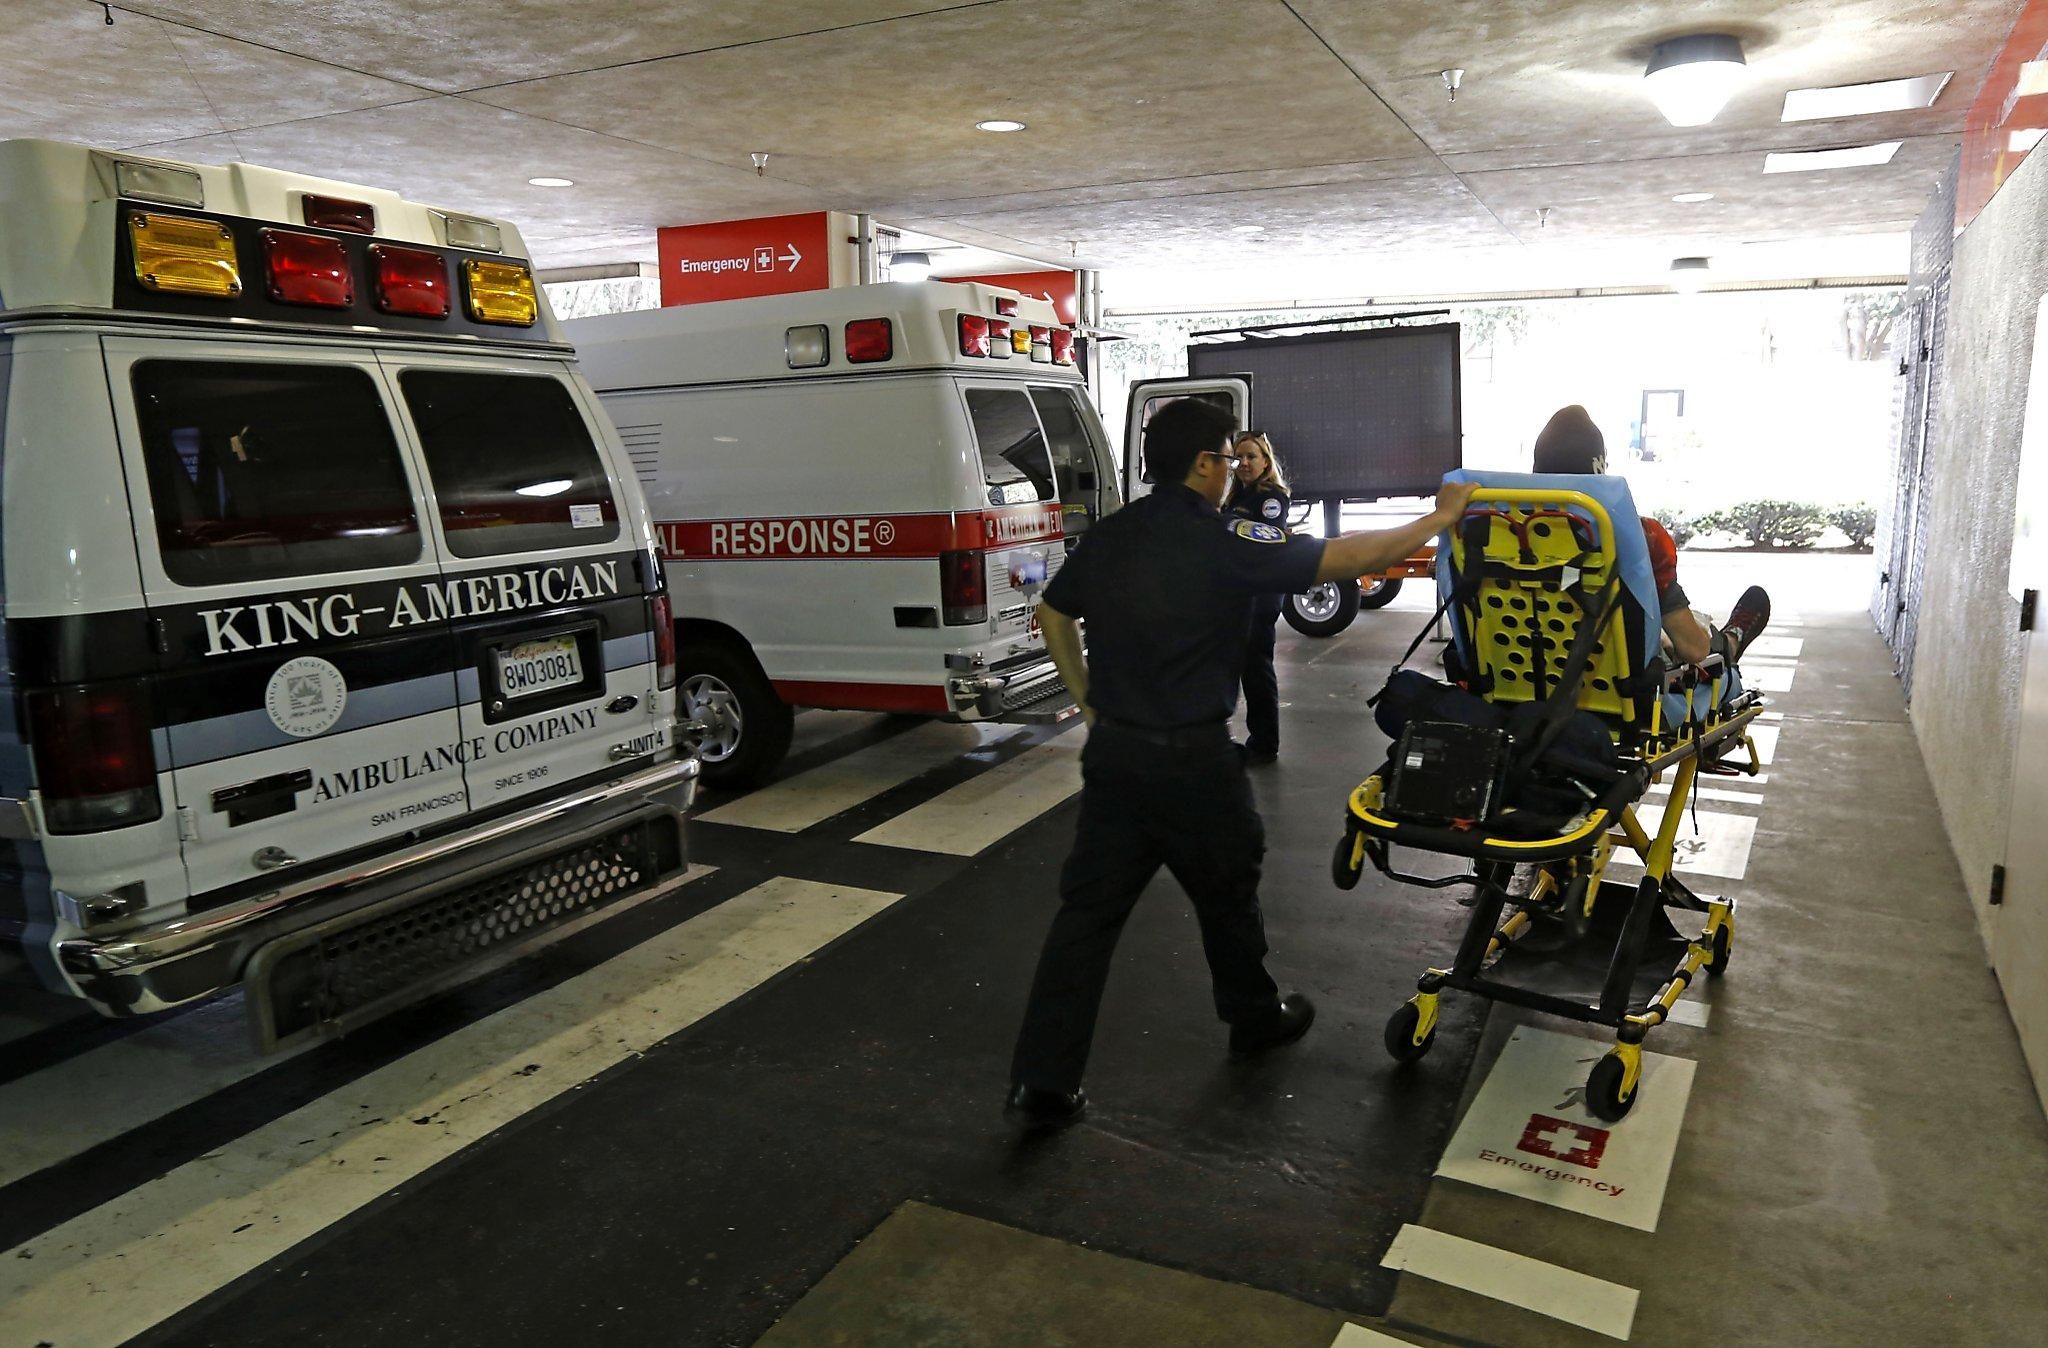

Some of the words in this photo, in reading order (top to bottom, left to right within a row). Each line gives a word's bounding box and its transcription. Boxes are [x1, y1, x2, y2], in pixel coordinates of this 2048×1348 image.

[681, 257, 750, 274] Emergency
[197, 560, 618, 657] KING-AMERICAN
[504, 653, 578, 690] 8W03081
[312, 736, 487, 804] AMBULANCE
[494, 706, 598, 754] COMPANY
[629, 733, 655, 752] UNIT
[657, 730, 664, 746] 4
[495, 773, 523, 790] SINCE
[527, 765, 549, 781] 1906
[371, 812, 396, 827] SAN
[400, 791, 465, 818] FRANCISCO
[1478, 1149, 1625, 1197] Emergency
